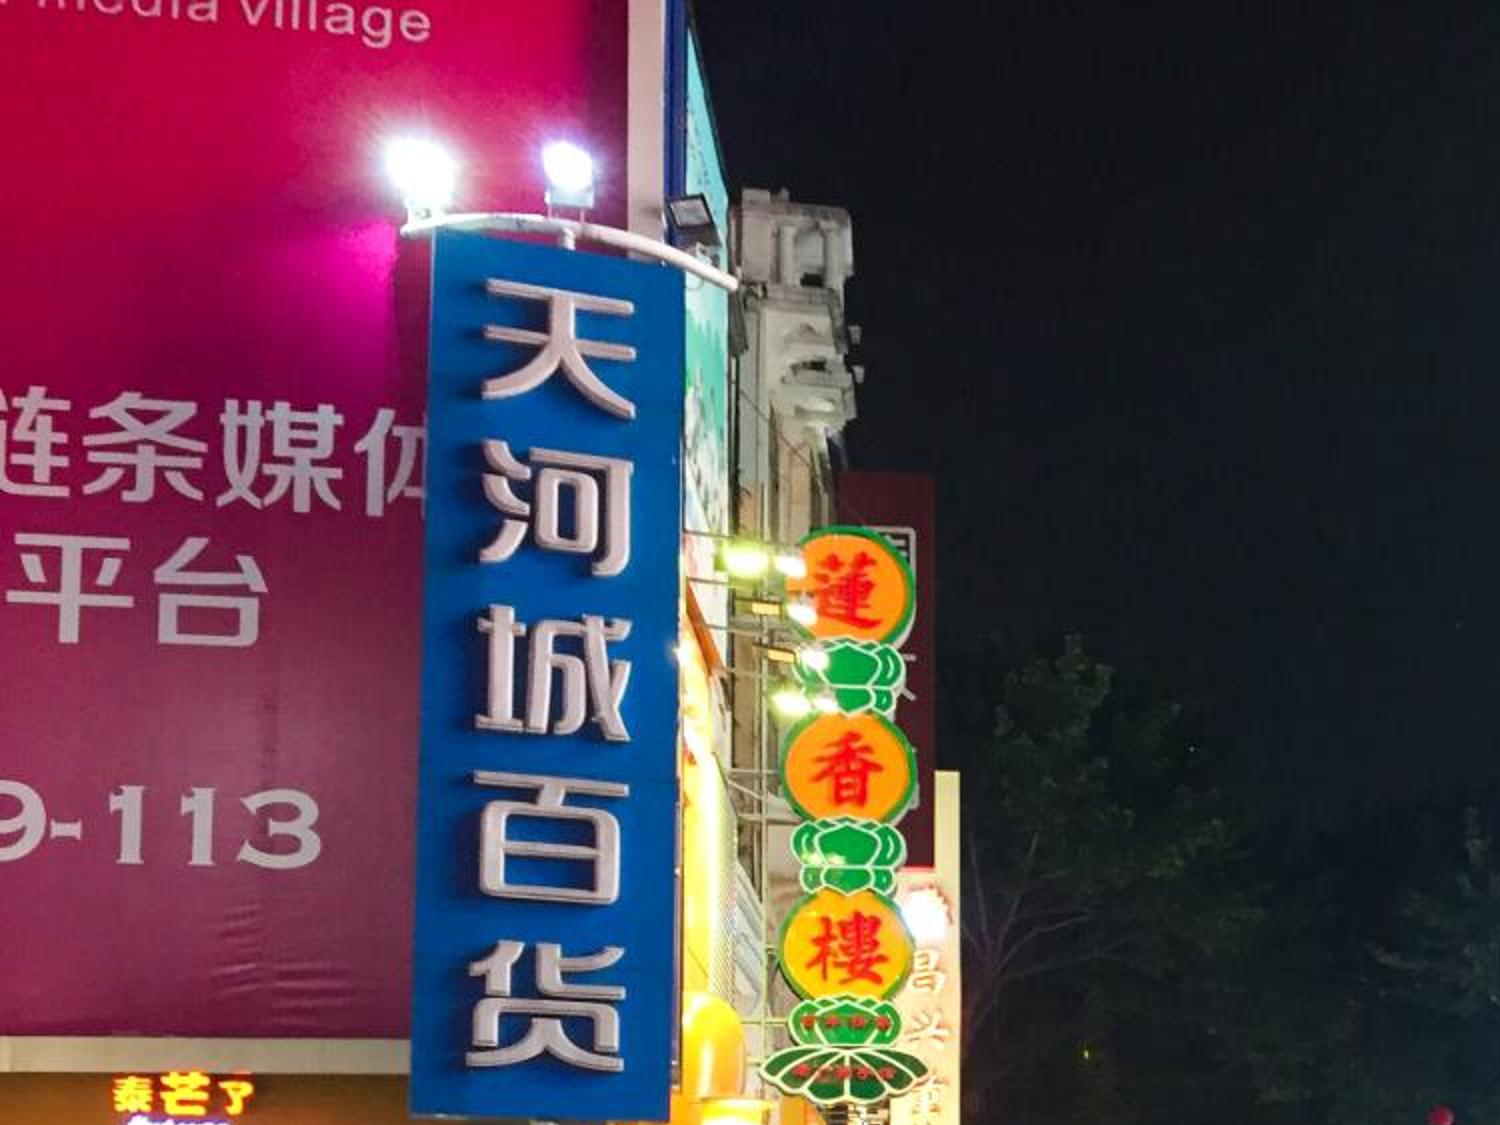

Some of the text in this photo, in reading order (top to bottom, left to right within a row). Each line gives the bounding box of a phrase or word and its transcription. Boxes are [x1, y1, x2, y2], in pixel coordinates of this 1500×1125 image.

[6, 532, 269, 648] 平台
[465, 277, 637, 1073] 天河城百货
